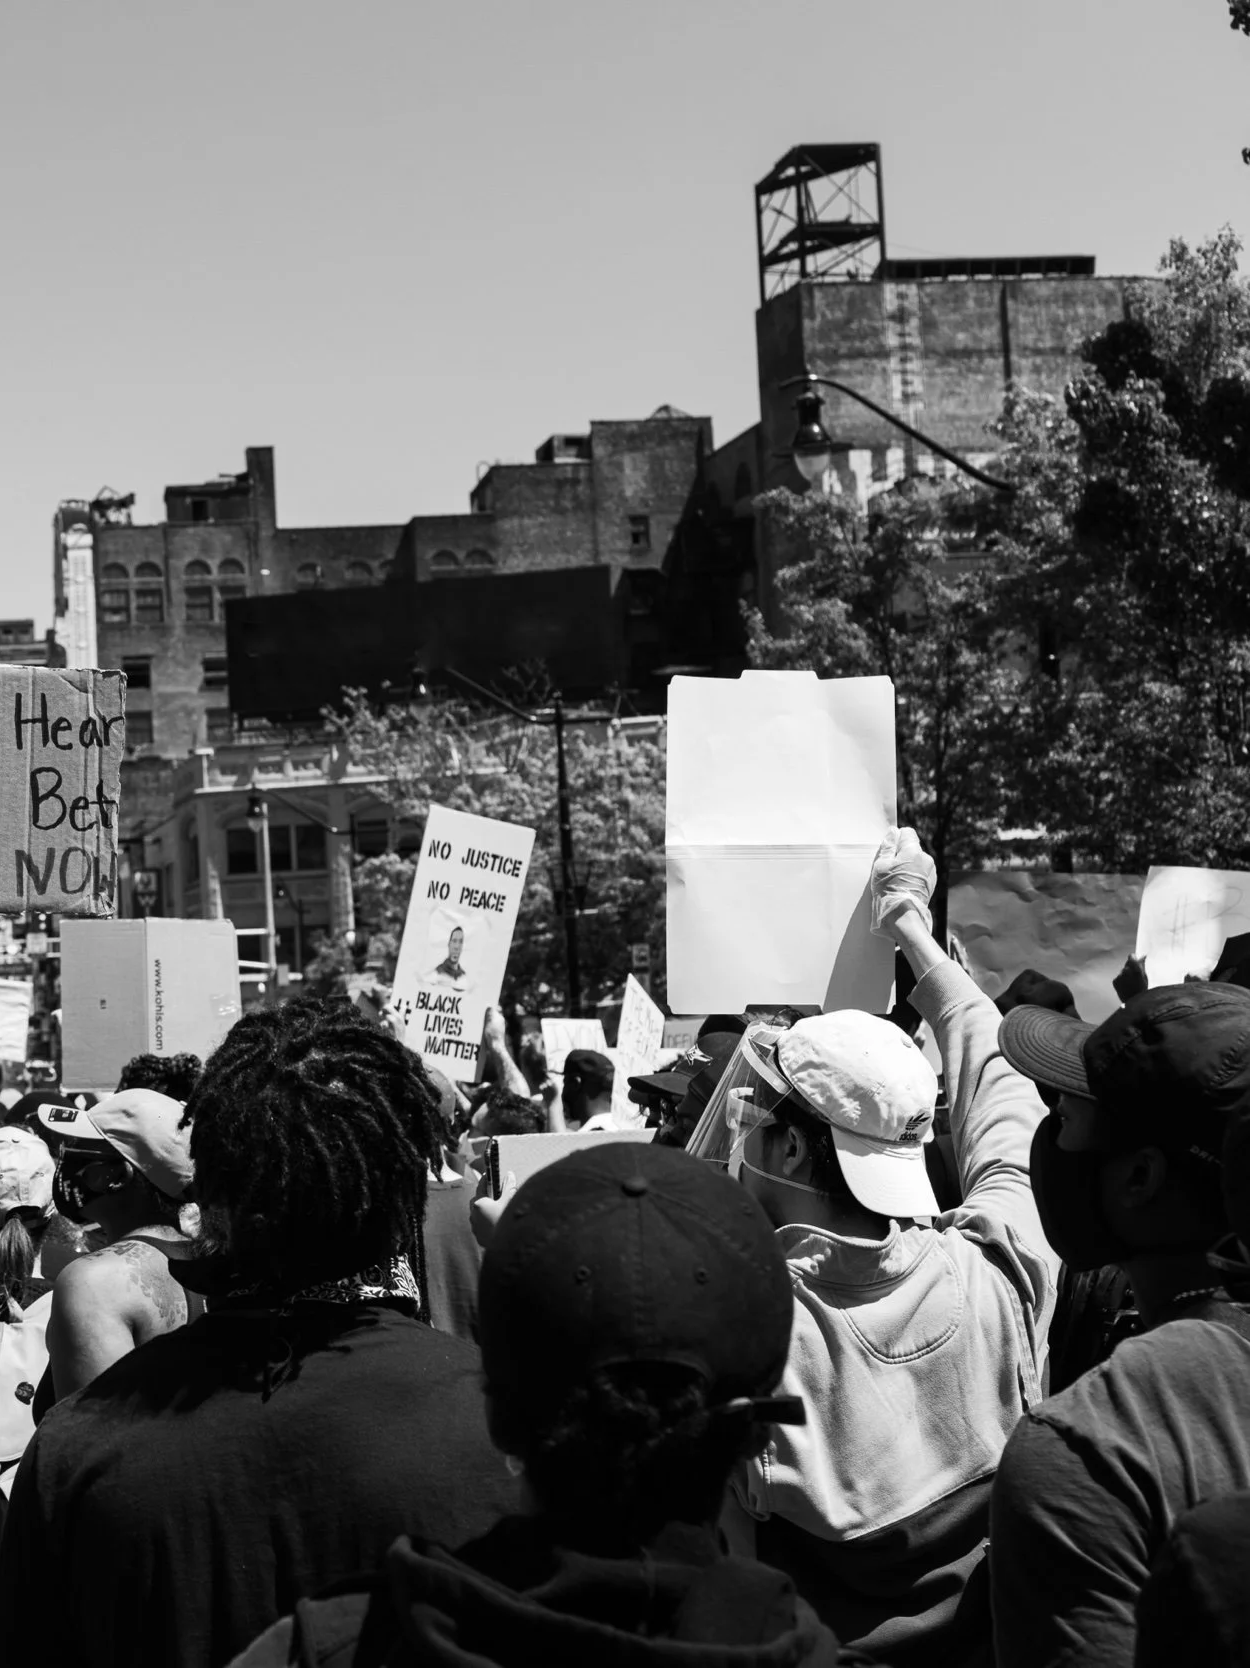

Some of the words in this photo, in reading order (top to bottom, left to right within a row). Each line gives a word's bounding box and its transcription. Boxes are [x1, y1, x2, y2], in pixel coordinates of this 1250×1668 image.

[14, 692, 125, 751] Hear
[30, 767, 118, 831] Bet
[428, 839, 452, 860] NO
[461, 848, 523, 878] JUSTICE
[427, 880, 451, 900] NO
[459, 886, 506, 913] PEACE
[154, 958, 164, 1051] www.kohls.com
[415, 991, 462, 1015] BLACK
[424, 1014, 463, 1037] LIVES
[424, 1036, 481, 1061] MATTER
